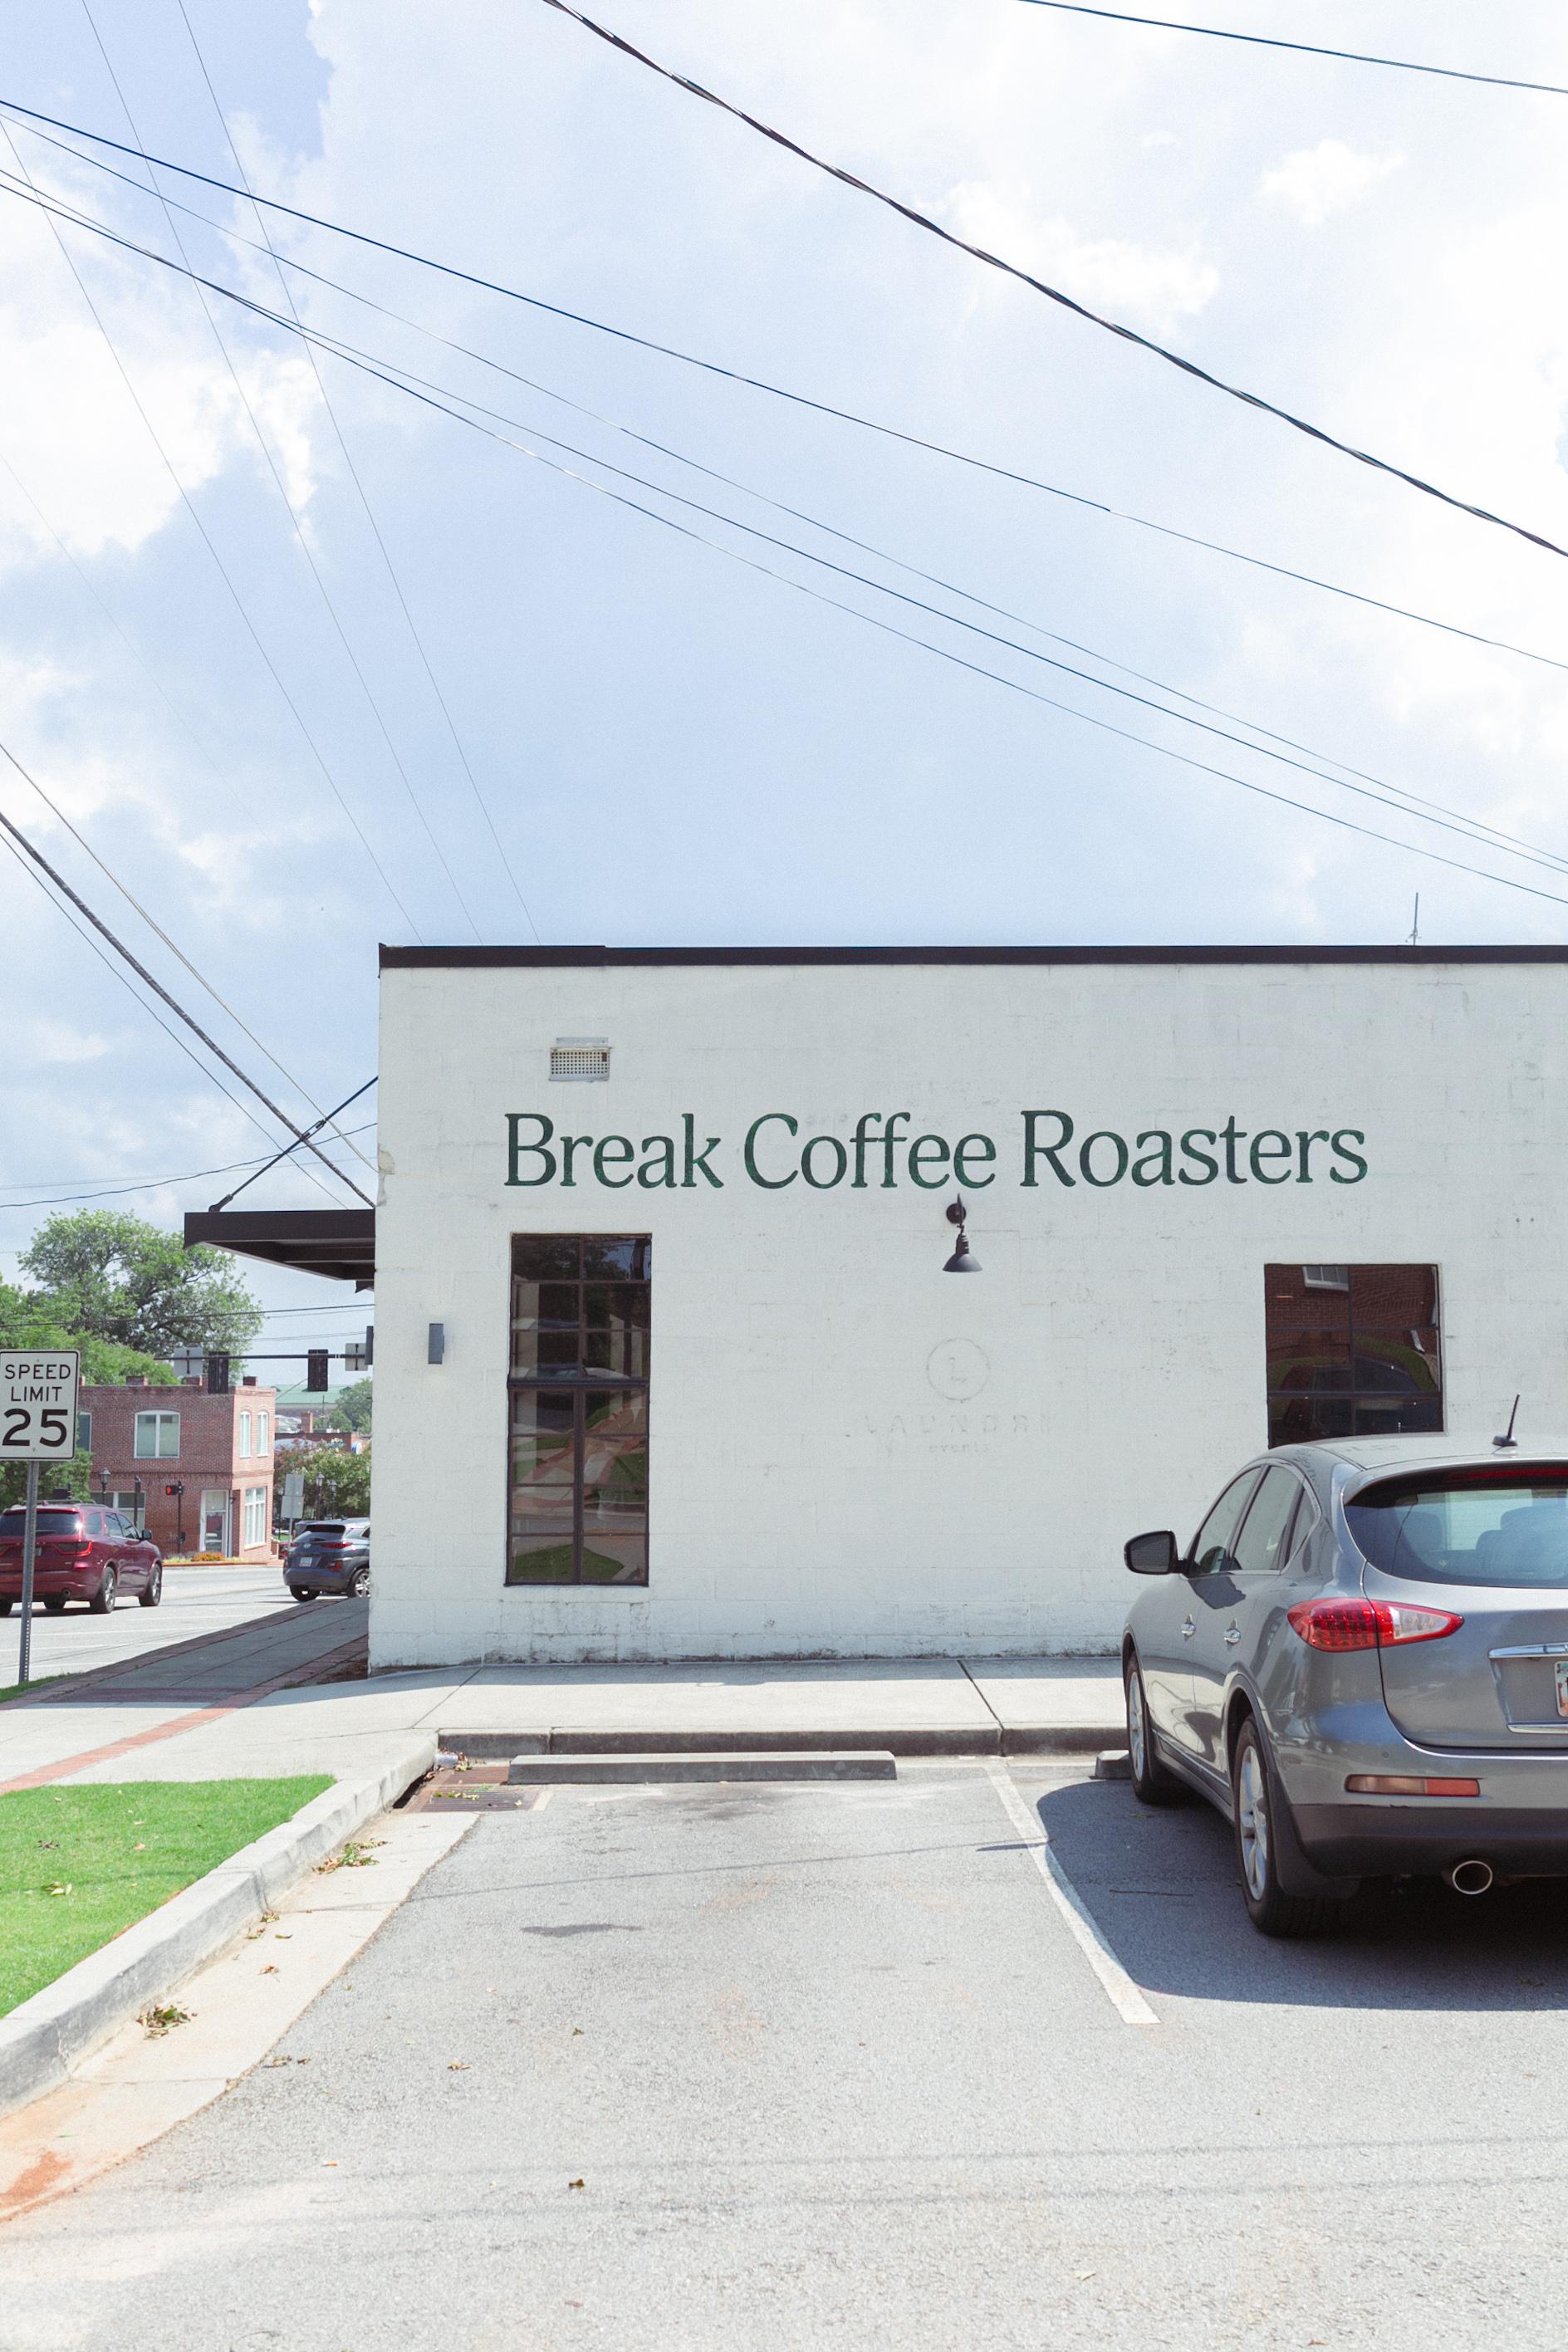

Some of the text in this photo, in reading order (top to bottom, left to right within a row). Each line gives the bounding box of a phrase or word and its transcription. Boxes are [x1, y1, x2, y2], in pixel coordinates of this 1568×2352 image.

[504, 1110, 1368, 1189] Break Coffee Roasters
[5, 1364, 71, 1379] SPEED
[11, 1386, 62, 1402] LIMIT
[2, 1408, 68, 1448] 25
